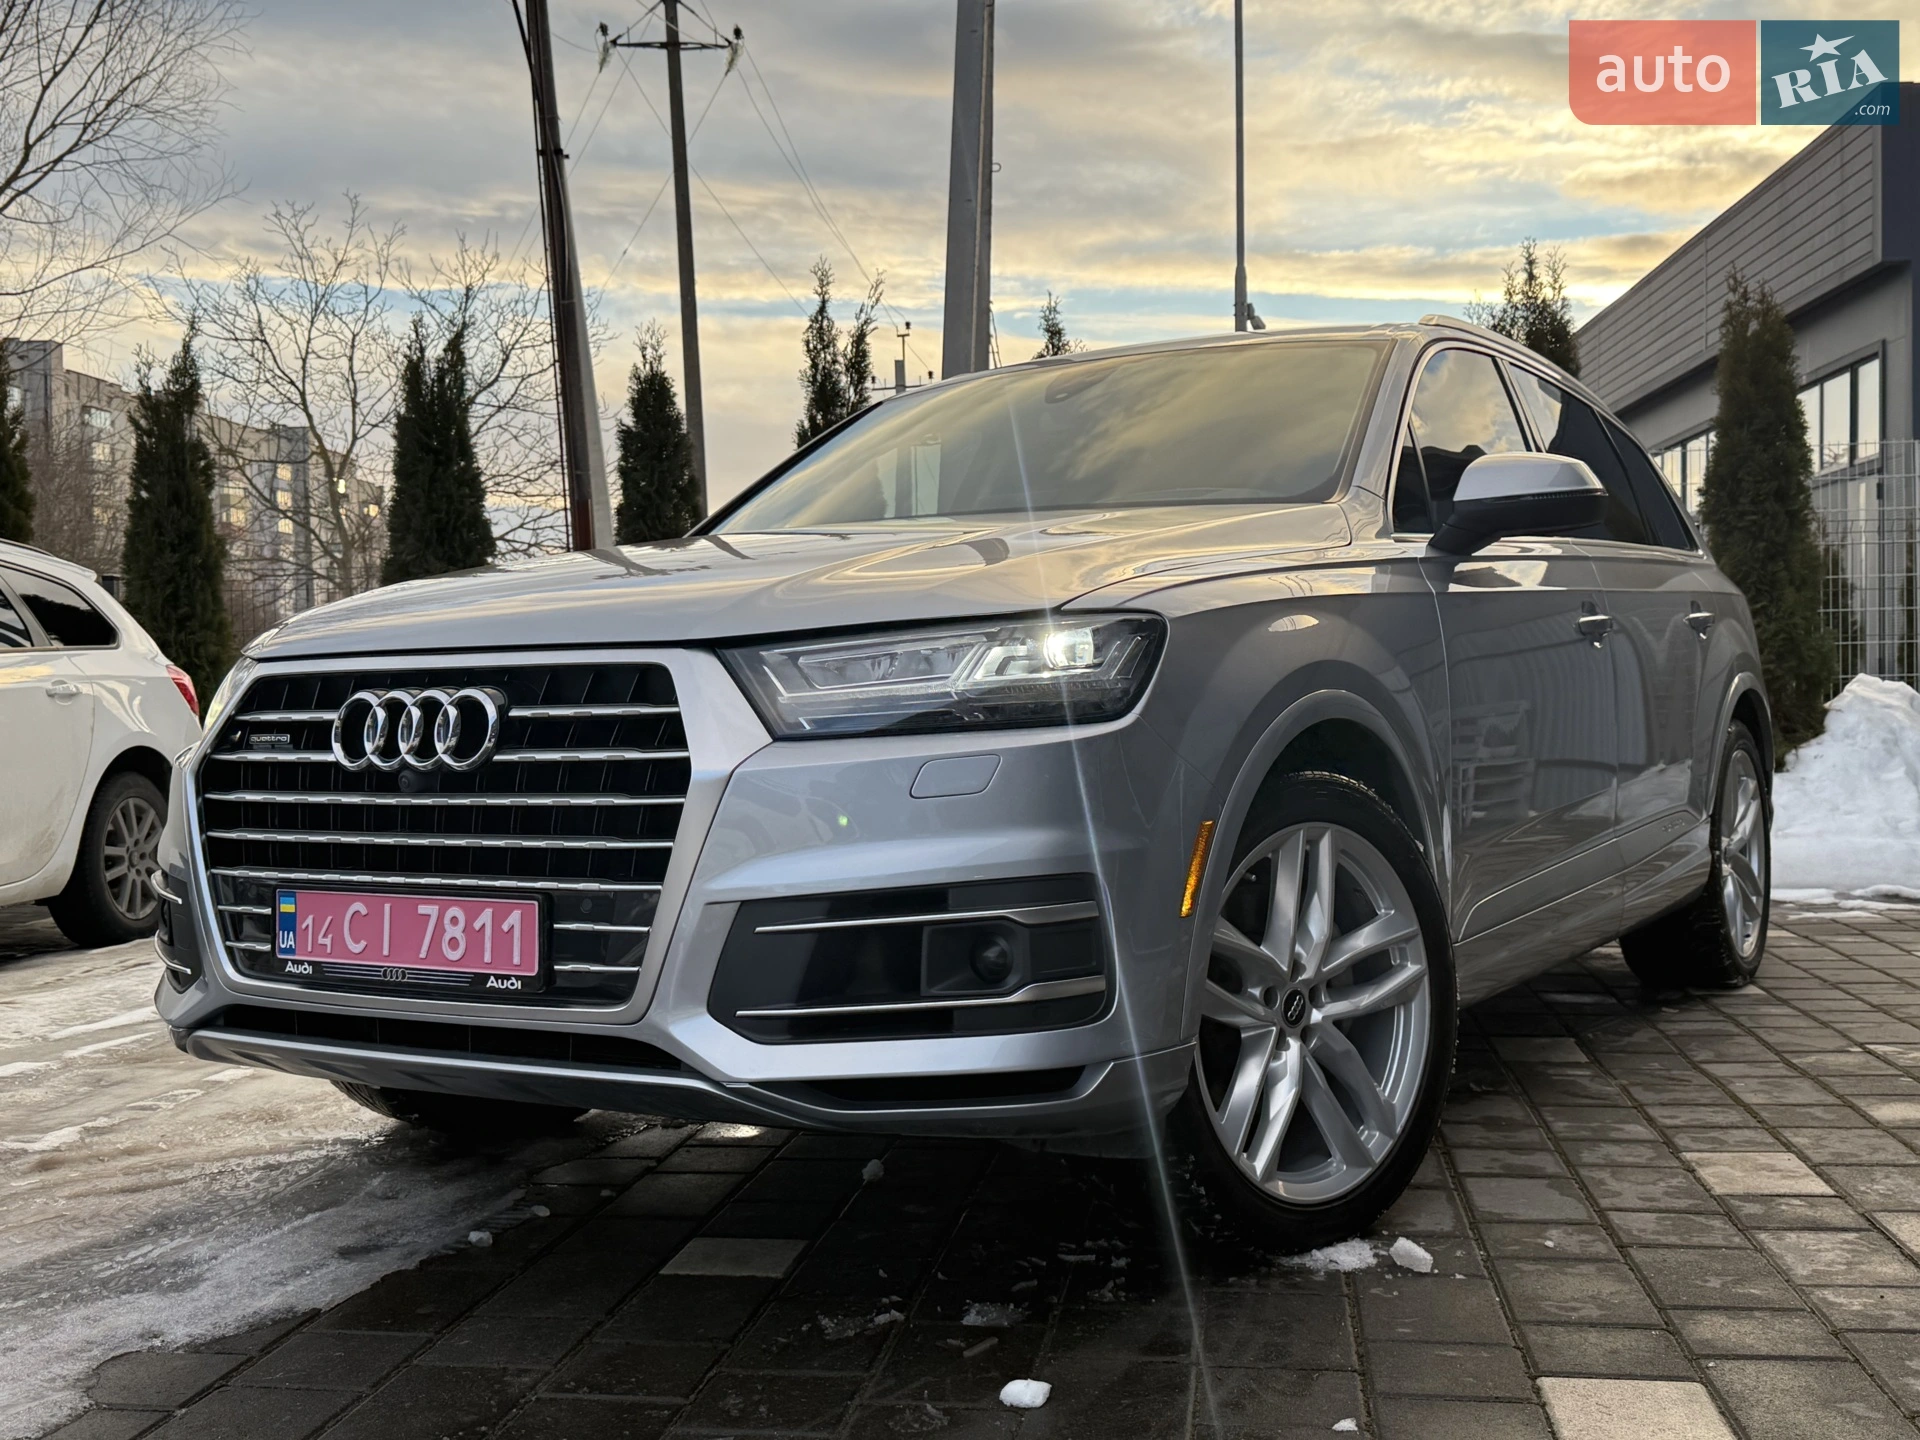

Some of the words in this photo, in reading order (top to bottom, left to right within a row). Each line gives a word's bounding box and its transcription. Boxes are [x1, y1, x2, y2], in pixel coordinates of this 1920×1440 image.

[250, 735, 288, 744] quattro
[279, 930, 295, 949] UA
[417, 904, 522, 966] 7811
[285, 961, 312, 975] Audi
[486, 975, 522, 990] Audi
